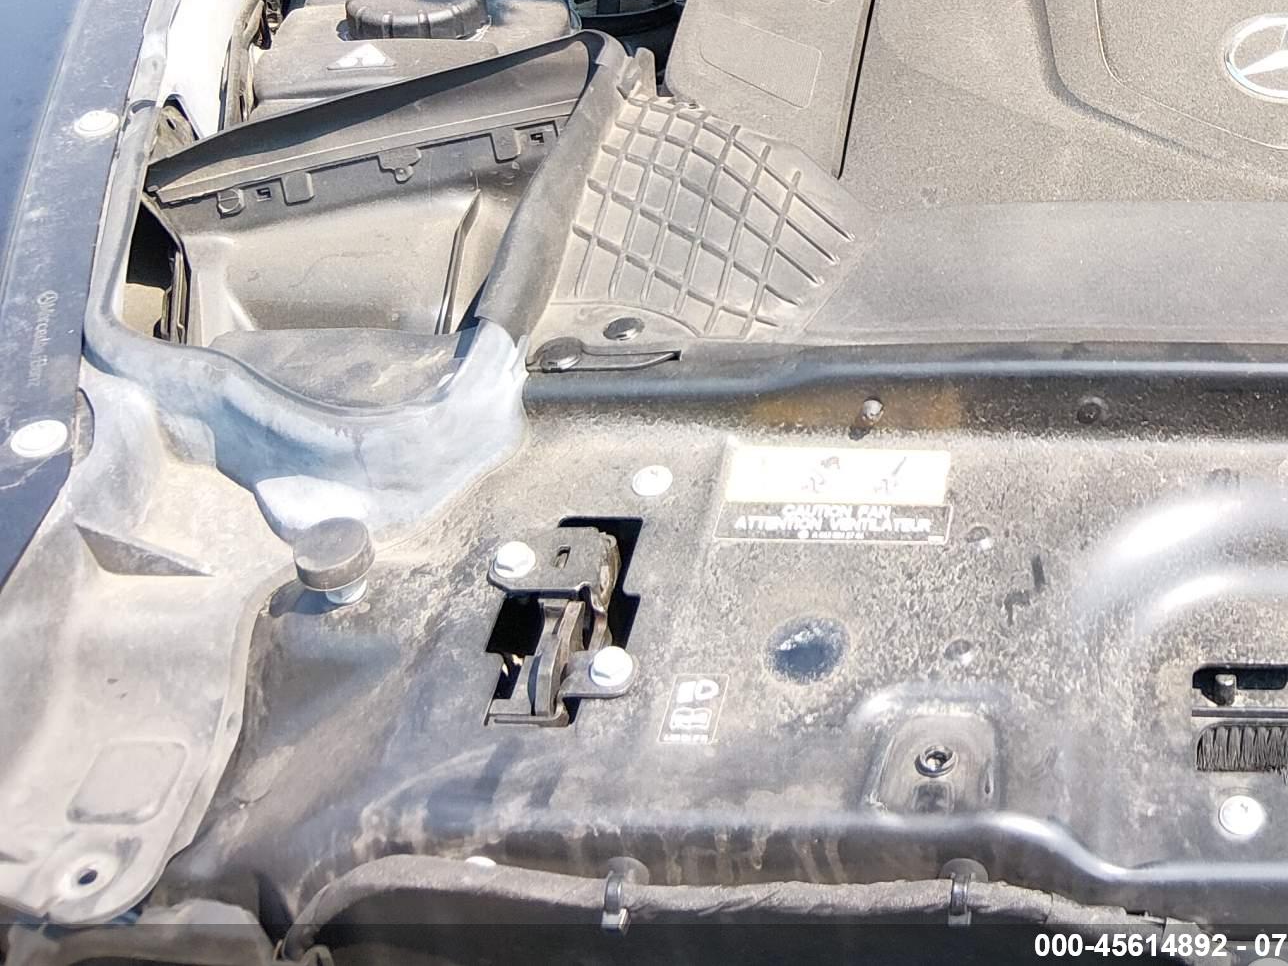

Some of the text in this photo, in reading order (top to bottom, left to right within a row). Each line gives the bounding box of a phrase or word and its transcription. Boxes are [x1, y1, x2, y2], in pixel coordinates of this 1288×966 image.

[782, 504, 892, 519] CAUTION FAN
[735, 515, 823, 531] ATTENTION
